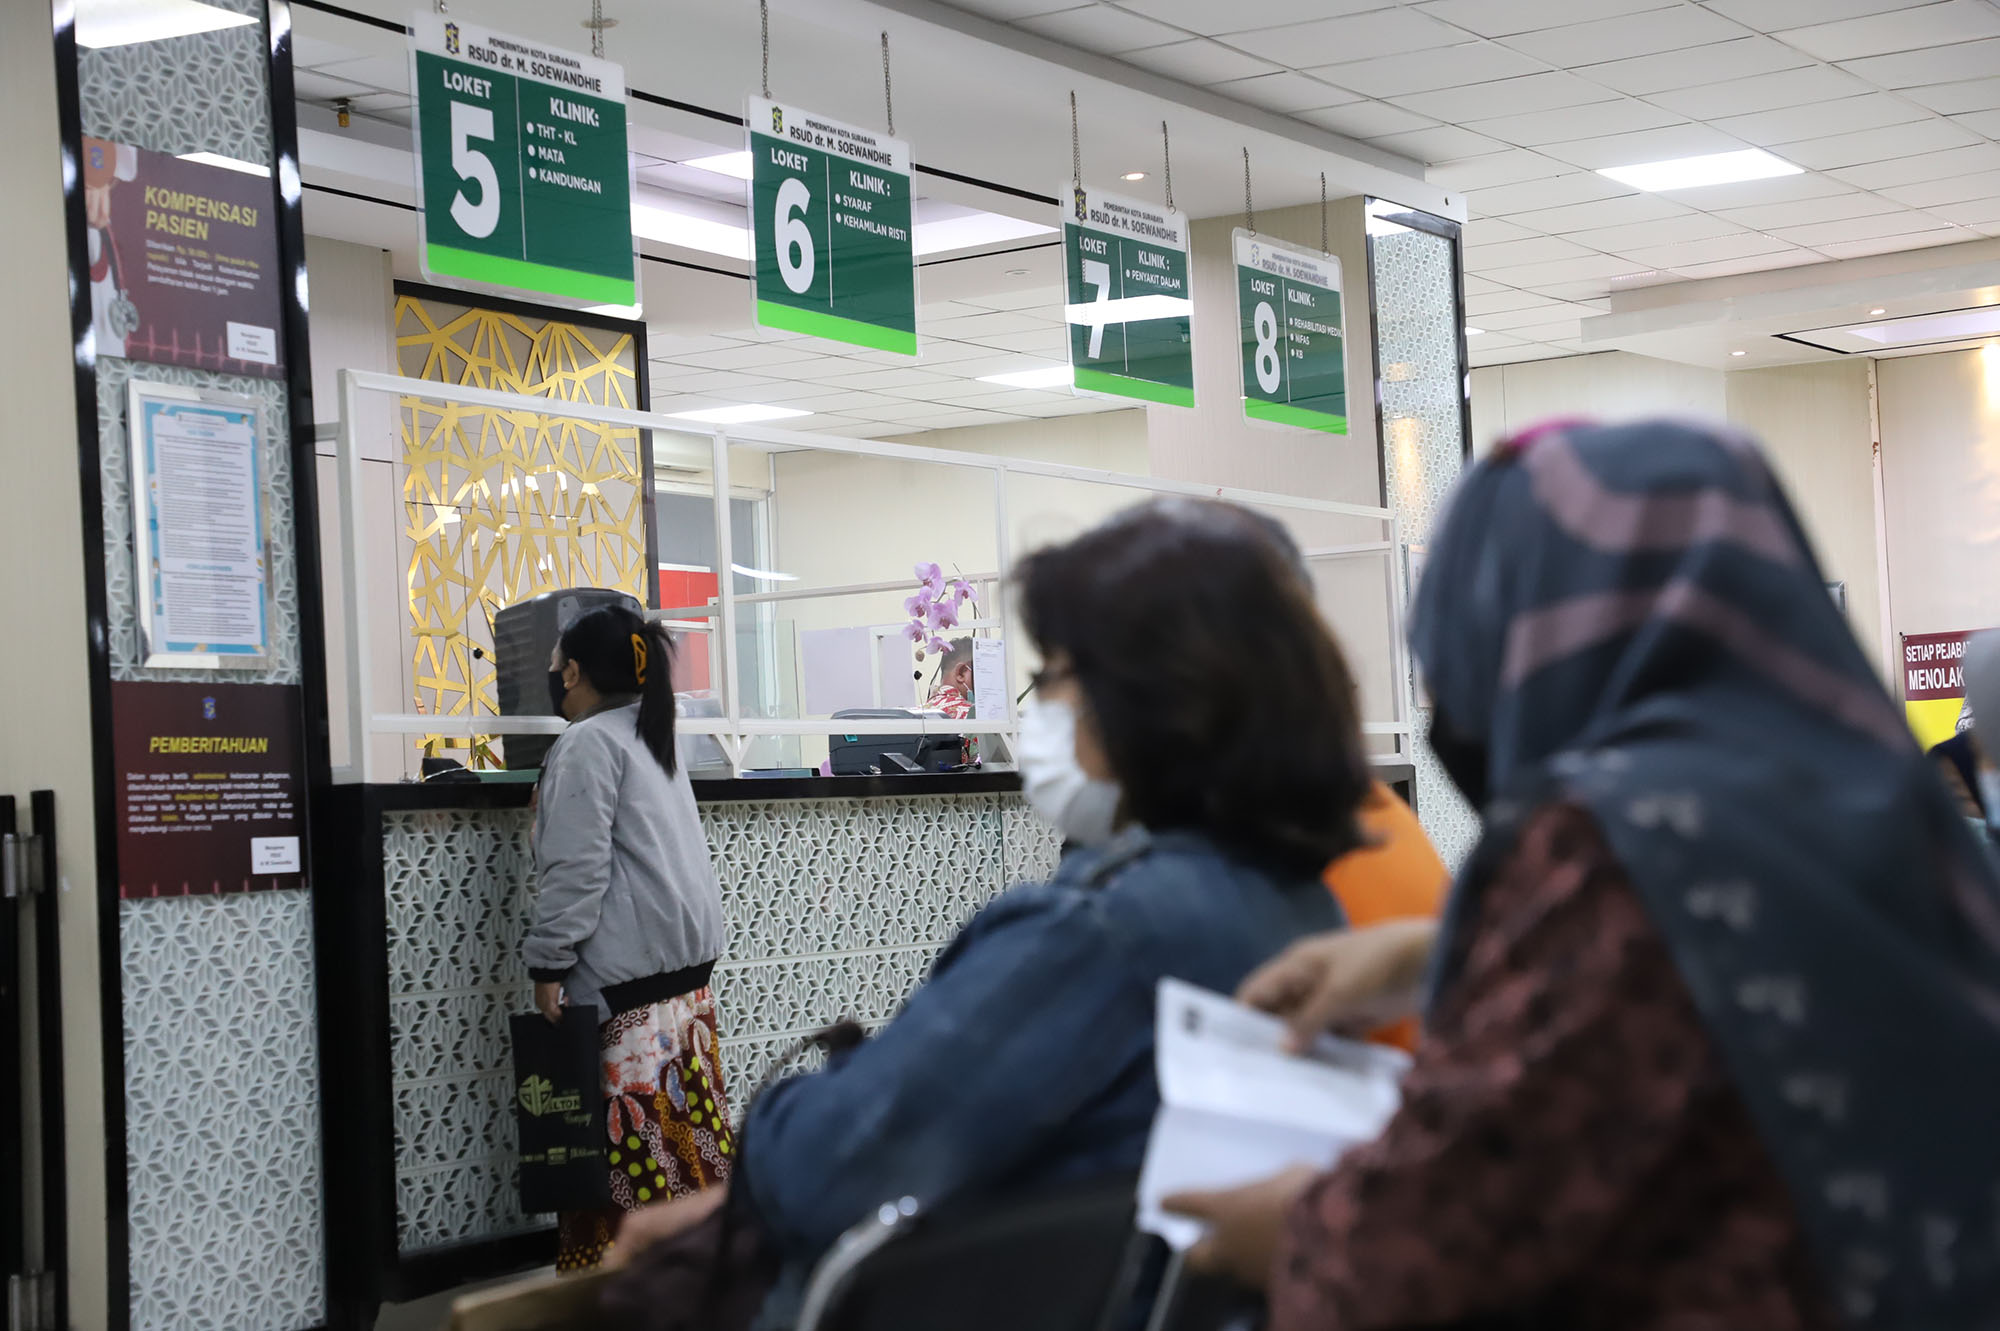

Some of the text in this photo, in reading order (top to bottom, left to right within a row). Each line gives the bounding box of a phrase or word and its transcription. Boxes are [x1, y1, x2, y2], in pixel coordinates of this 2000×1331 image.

[489, 37, 581, 70] PEMERINTAH KOTA SURABAYA
[468, 45, 602, 93] RSUD dr. M. SOEWANDHIE
[443, 69, 492, 99] LOKET
[537, 124, 556, 140] THT
[564, 131, 578, 146] KL
[805, 119, 877, 146] PEMERINTAH KOTA SURABAYA
[538, 146, 566, 164] MATA
[790, 126, 892, 166] RSUD dr. M. SOEWANDHIE
[450, 100, 500, 238] 5
[771, 147, 809, 172] LOKET
[539, 168, 602, 194] KANDUNGAN
[144, 185, 257, 228] KOMPENSASI
[842, 195, 873, 213] SYARAF
[145, 210, 209, 240] PASIEN
[774, 177, 815, 294] 6
[843, 214, 907, 242] KEHAMILAN RISTI
[1090, 209, 1178, 243] RSUD dr. M. SOEWANDHIE
[1079, 235, 1107, 255] LOKET
[1131, 269, 1181, 288] PENYAKIT DALAM
[1251, 278, 1275, 296] LOKET
[1082, 258, 1110, 359] 7
[1294, 317, 1327, 335] REHABILITASI
[1295, 333, 1310, 345] NIFAS
[1254, 301, 1280, 394] 8
[1295, 348, 1304, 359] KB
[1906, 641, 1971, 662] SETIAP PEJABA
[1908, 666, 1965, 690] MENOLAK
[149, 737, 268, 753] PEMBERITAHUAN
